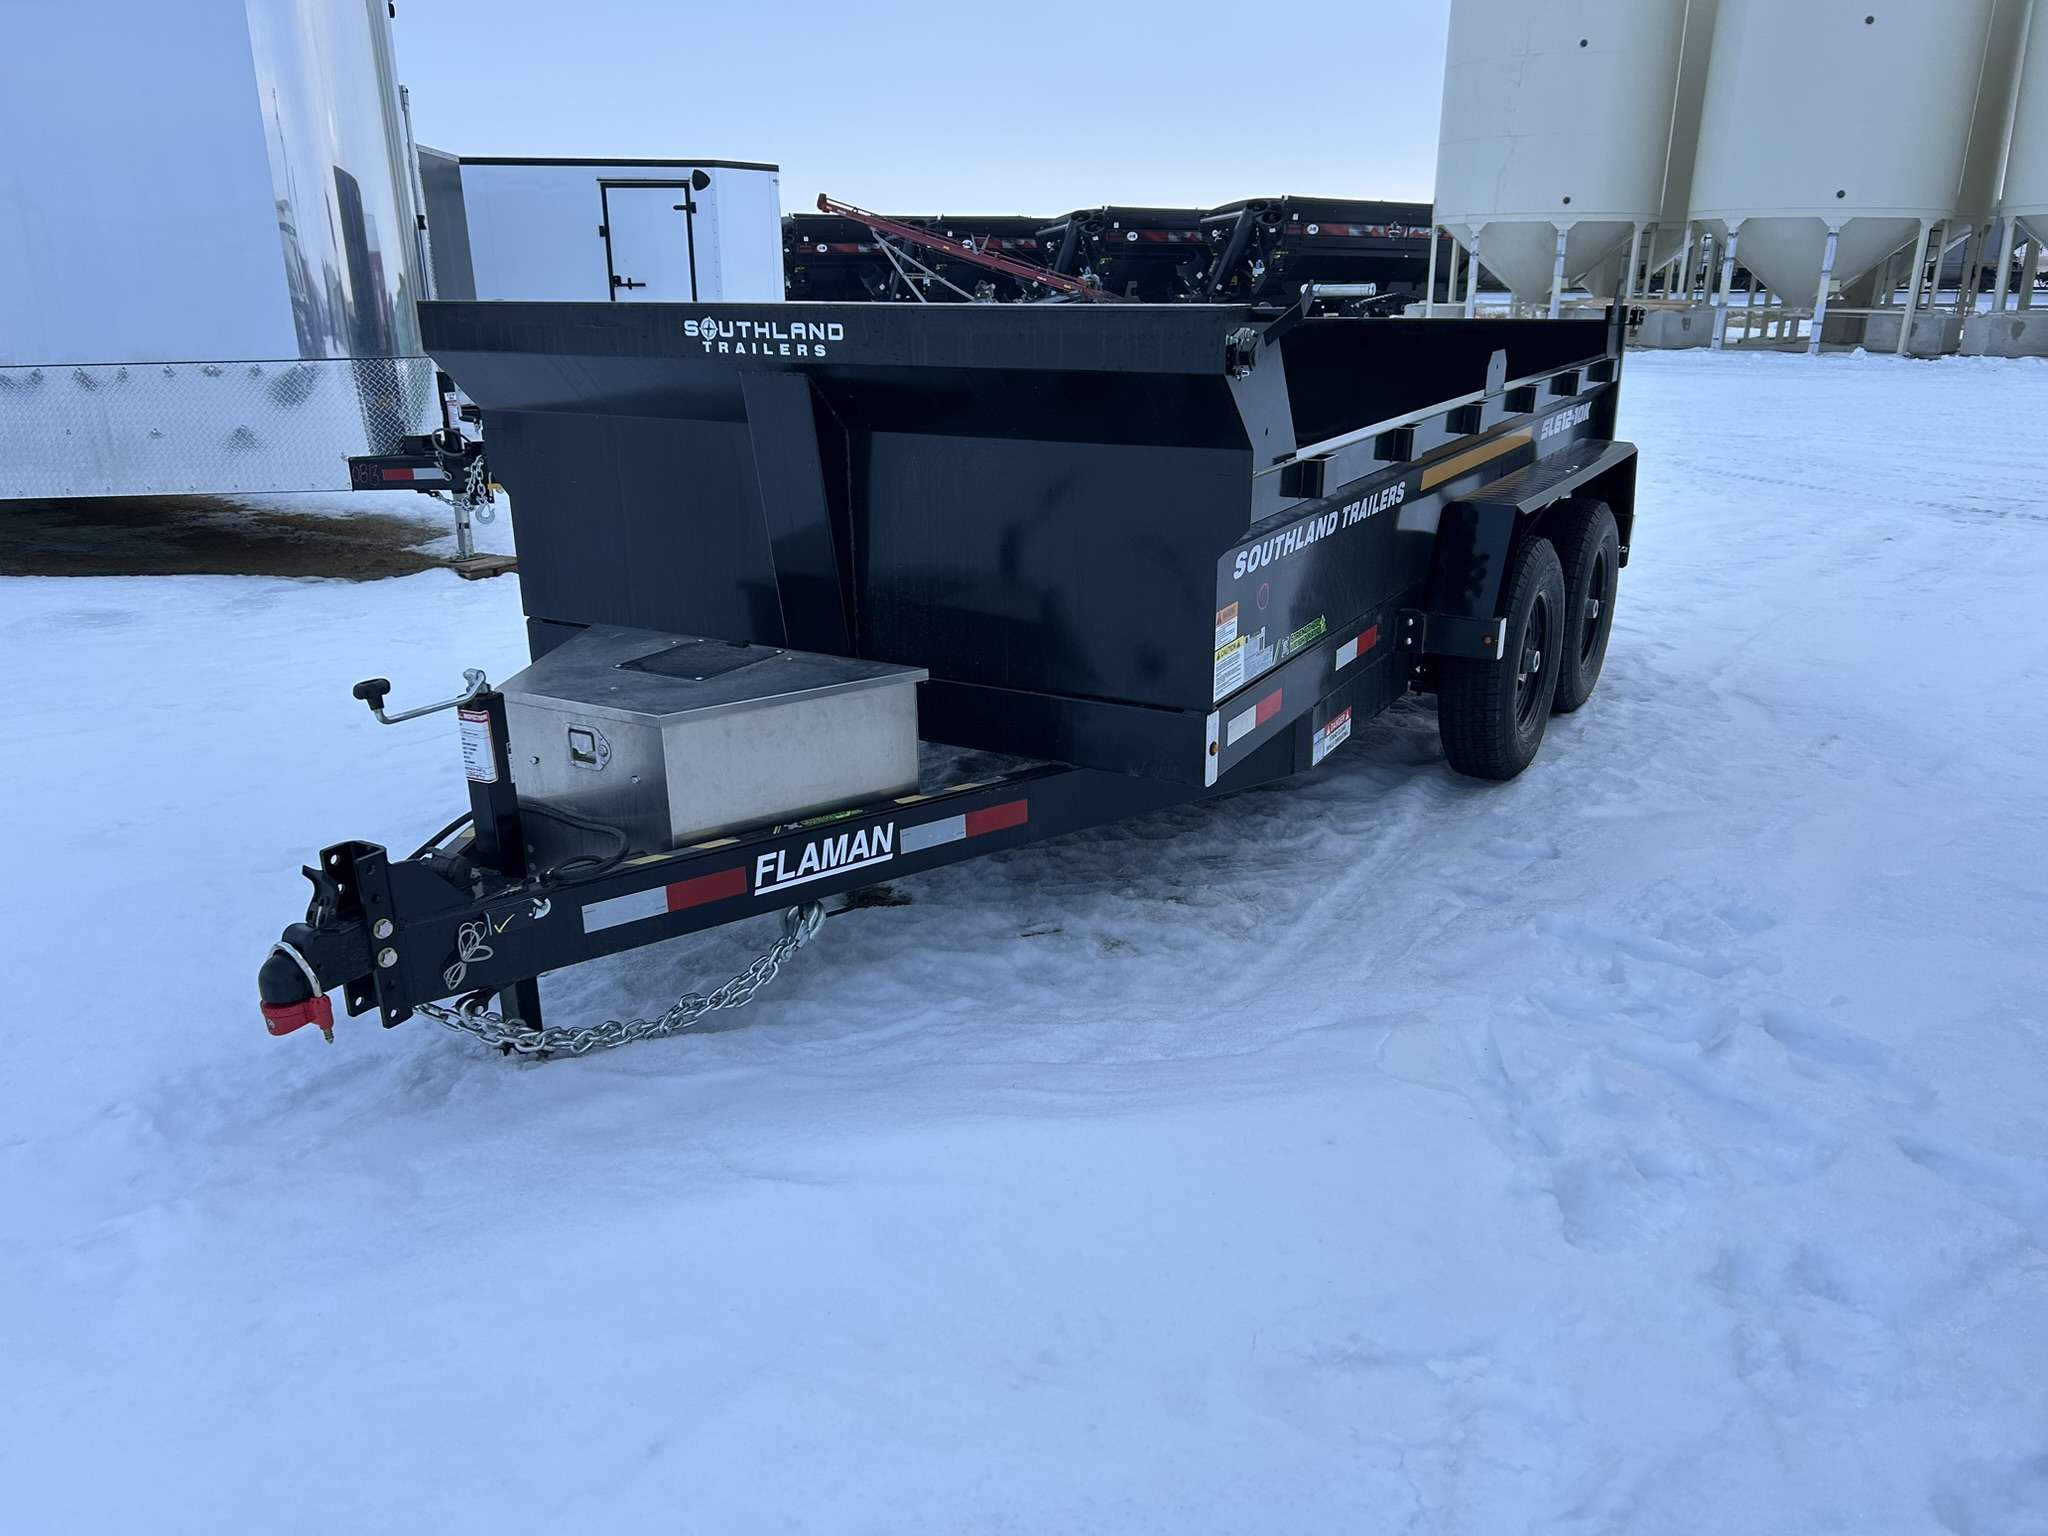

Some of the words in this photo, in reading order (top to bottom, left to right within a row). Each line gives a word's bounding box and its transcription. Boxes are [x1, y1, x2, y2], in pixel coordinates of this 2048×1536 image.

[683, 316, 845, 341] SOUTHLAND
[702, 341, 827, 357] TRAILERS
[1232, 510, 1339, 580] SOUTHLAND
[1341, 480, 1407, 529] TRAILERS
[754, 821, 894, 888] FLAMAN
